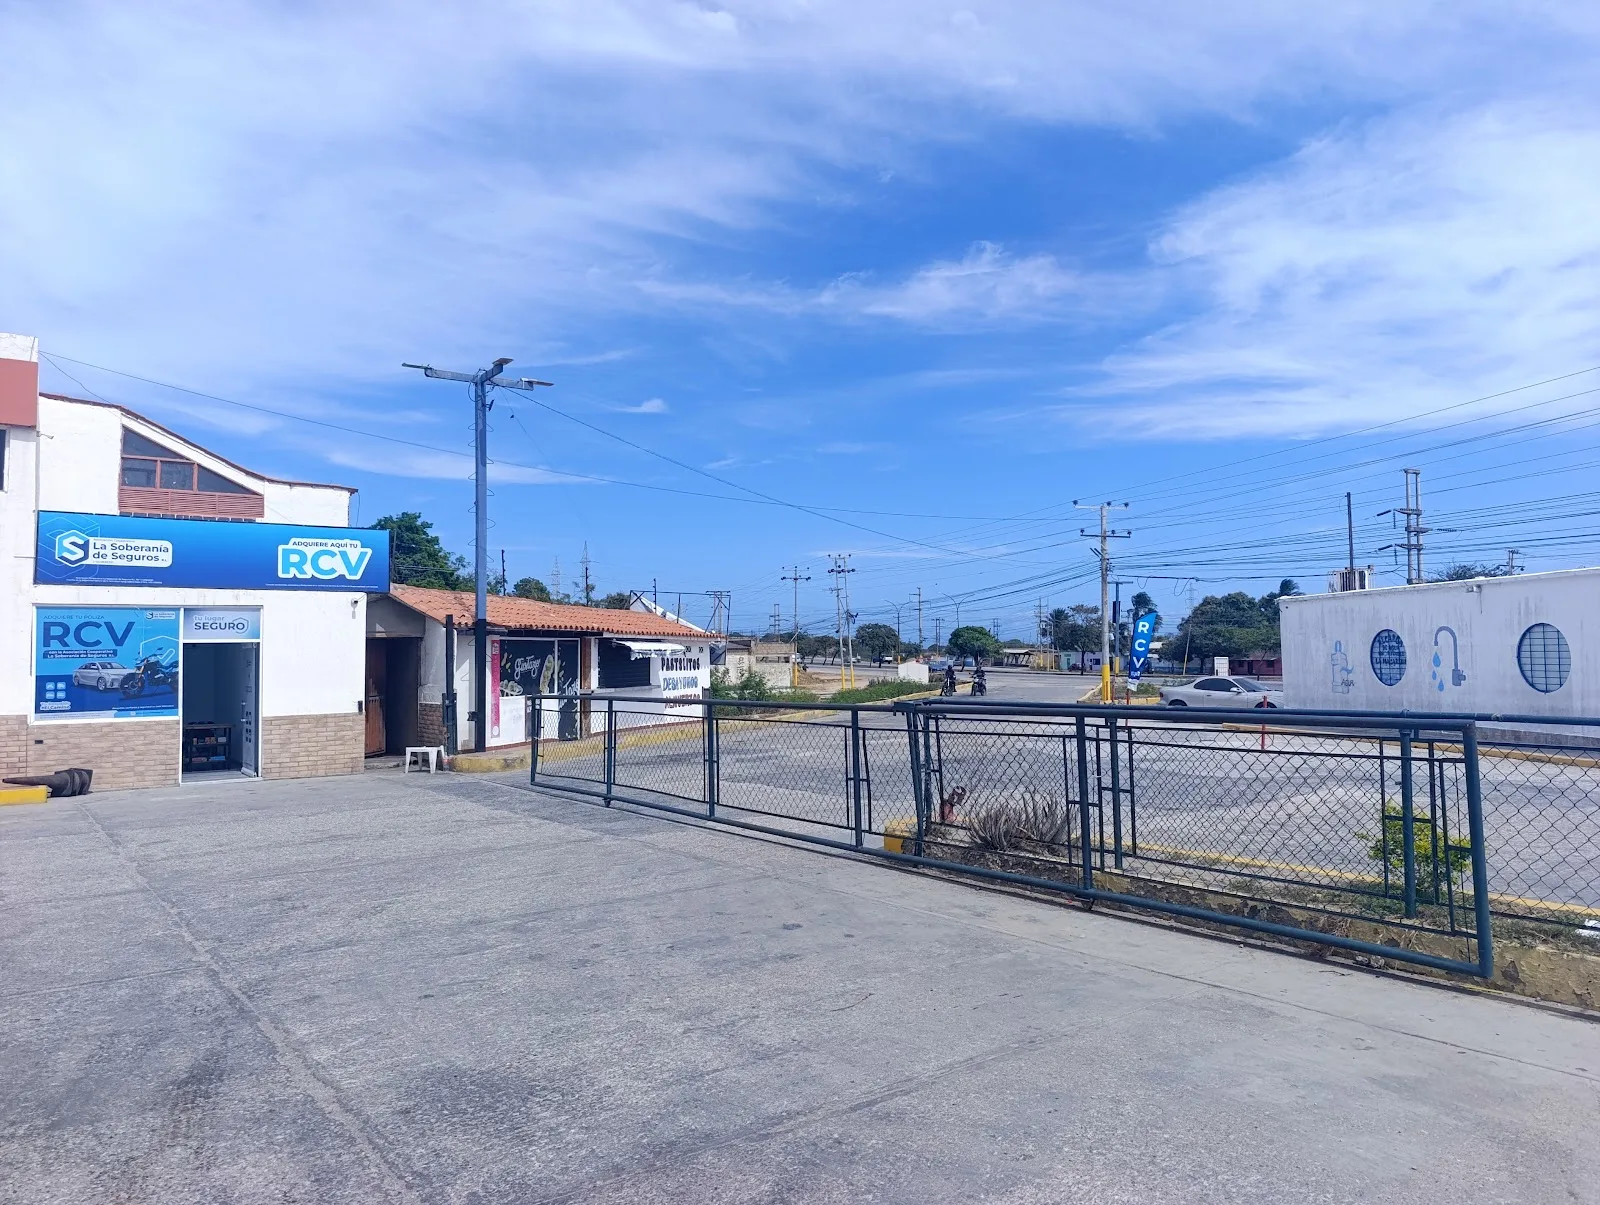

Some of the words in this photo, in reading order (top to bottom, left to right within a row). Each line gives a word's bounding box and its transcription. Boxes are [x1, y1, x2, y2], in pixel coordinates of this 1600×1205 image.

[92, 551, 108, 560] de
[111, 552, 160, 562] Seguros
[93, 542, 107, 550] La
[110, 542, 169, 553] Soberanía
[281, 548, 369, 577] RCV
[43, 620, 136, 648] RCV
[194, 621, 245, 631] SEGURO
[1132, 621, 1150, 669] RCV
